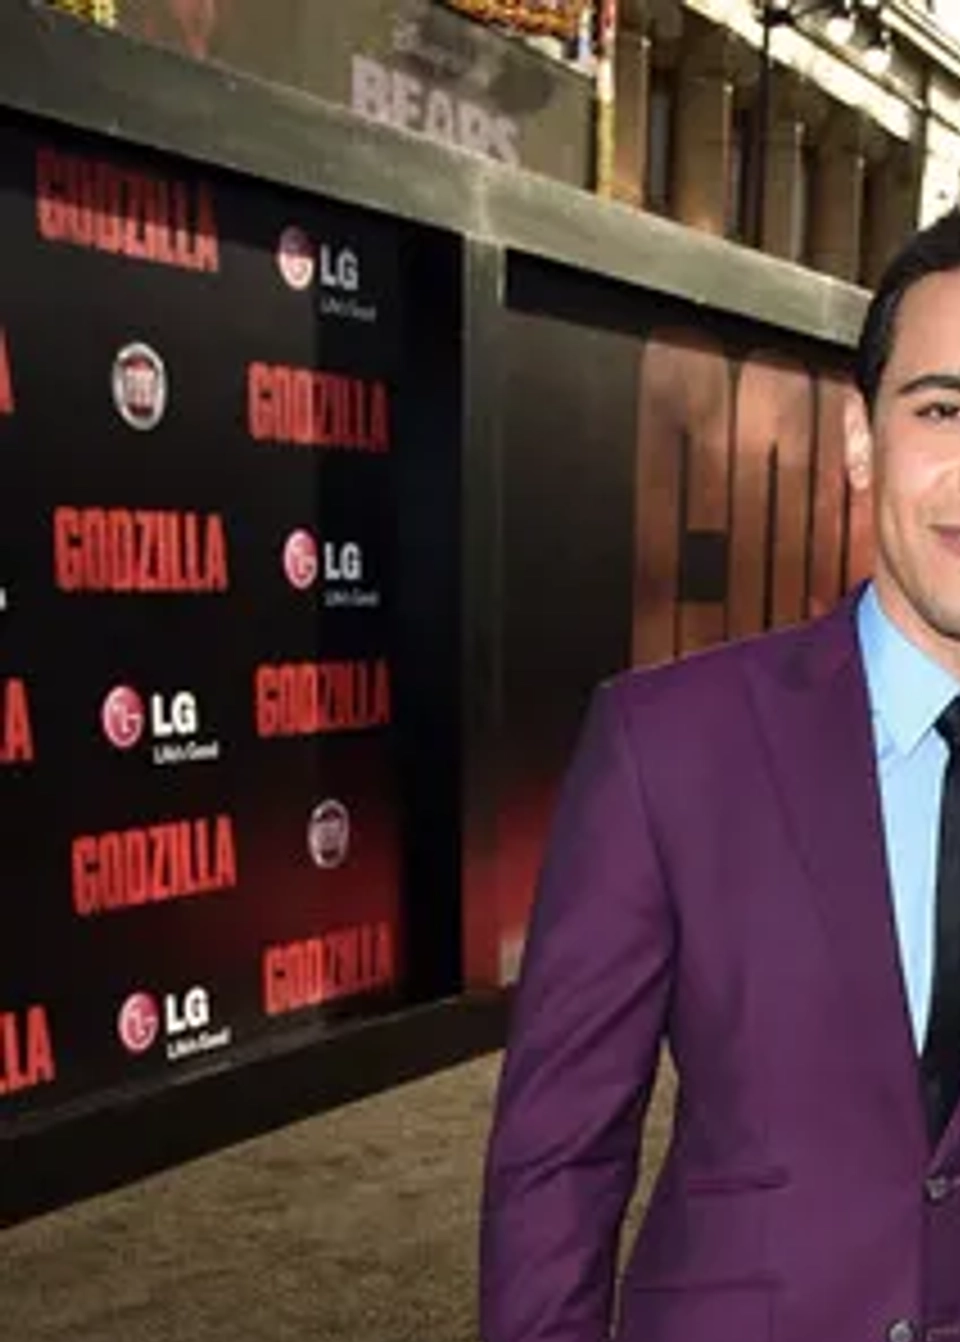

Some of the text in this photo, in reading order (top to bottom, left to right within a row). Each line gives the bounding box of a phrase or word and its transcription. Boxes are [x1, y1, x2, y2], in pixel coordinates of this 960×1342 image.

[36, 148, 219, 273] GODZILLA
[320, 244, 358, 291] LG
[248, 361, 390, 452] GODZILLA
[54, 505, 228, 591] GODZILLA
[325, 541, 362, 579] LG
[152, 691, 197, 737] LG
[257, 660, 390, 738] GODZILLA
[72, 814, 236, 916] GODZILLA
[265, 921, 394, 1016] GODZILLA
[166, 986, 209, 1034] LG
